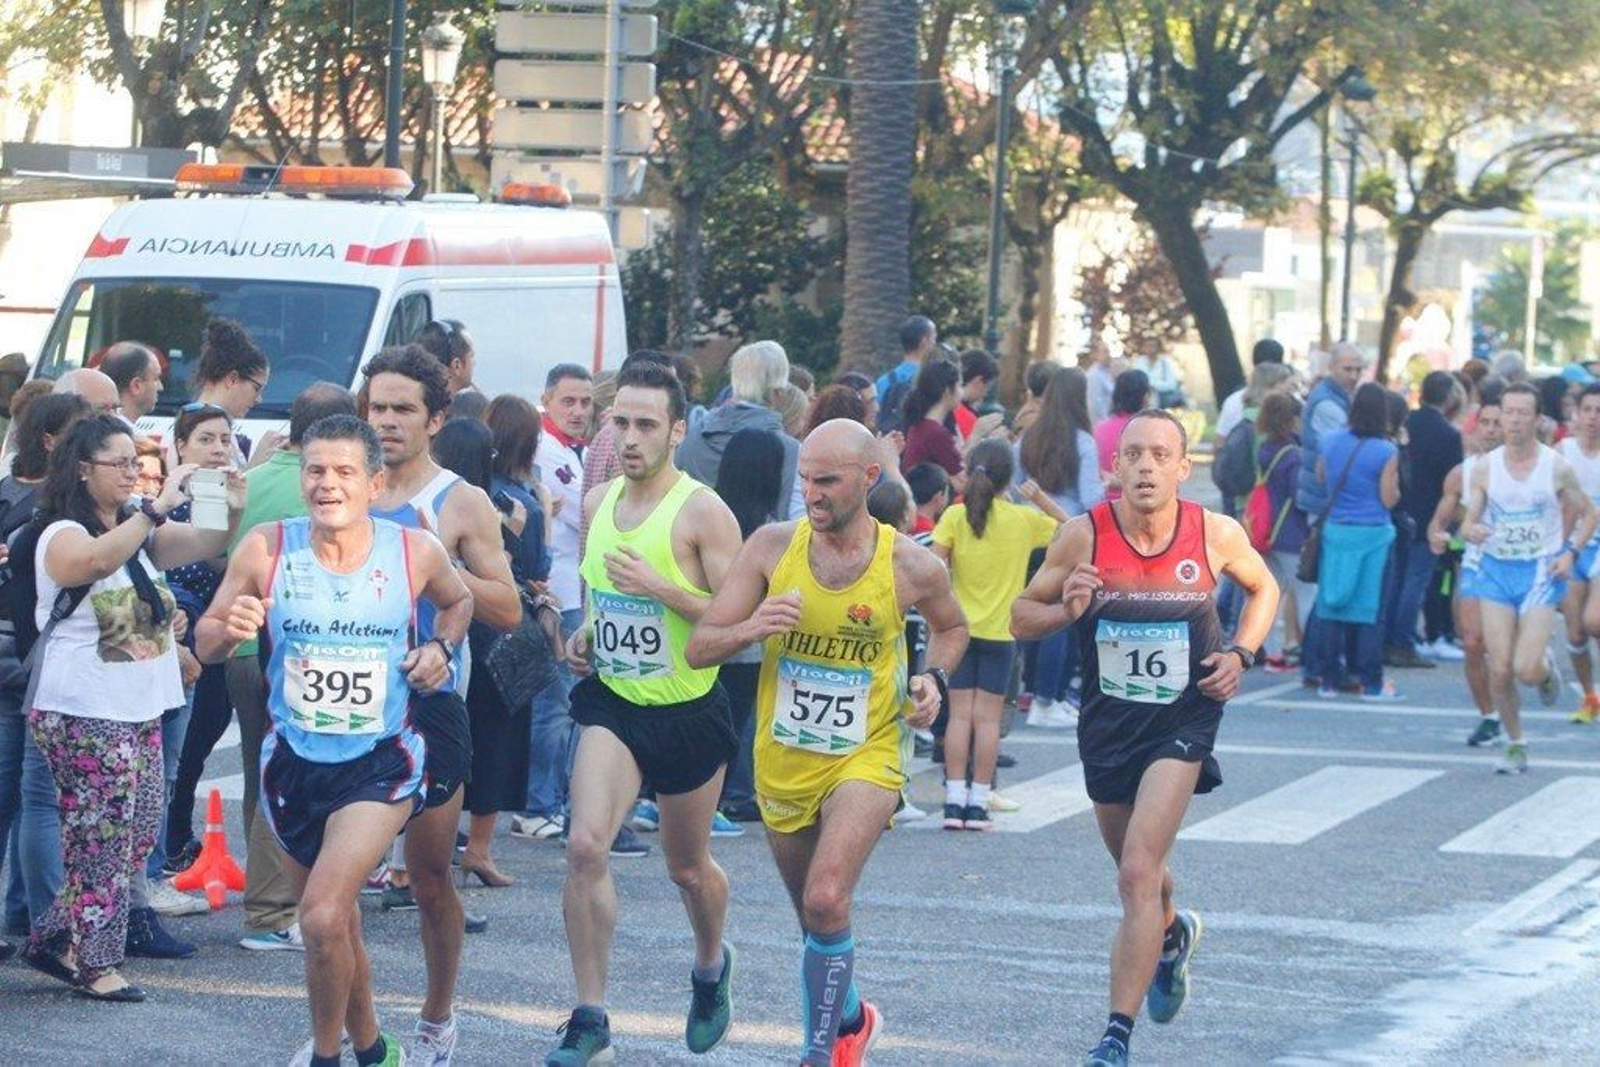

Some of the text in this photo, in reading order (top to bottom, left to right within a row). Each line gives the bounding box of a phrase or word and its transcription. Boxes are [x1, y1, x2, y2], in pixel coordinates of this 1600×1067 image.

[1505, 526, 1540, 544] 236
[282, 619, 320, 635] Celta
[594, 618, 662, 655] 1049
[1125, 649, 1167, 678] 16
[302, 669, 373, 705] 395
[789, 689, 855, 727] 575
